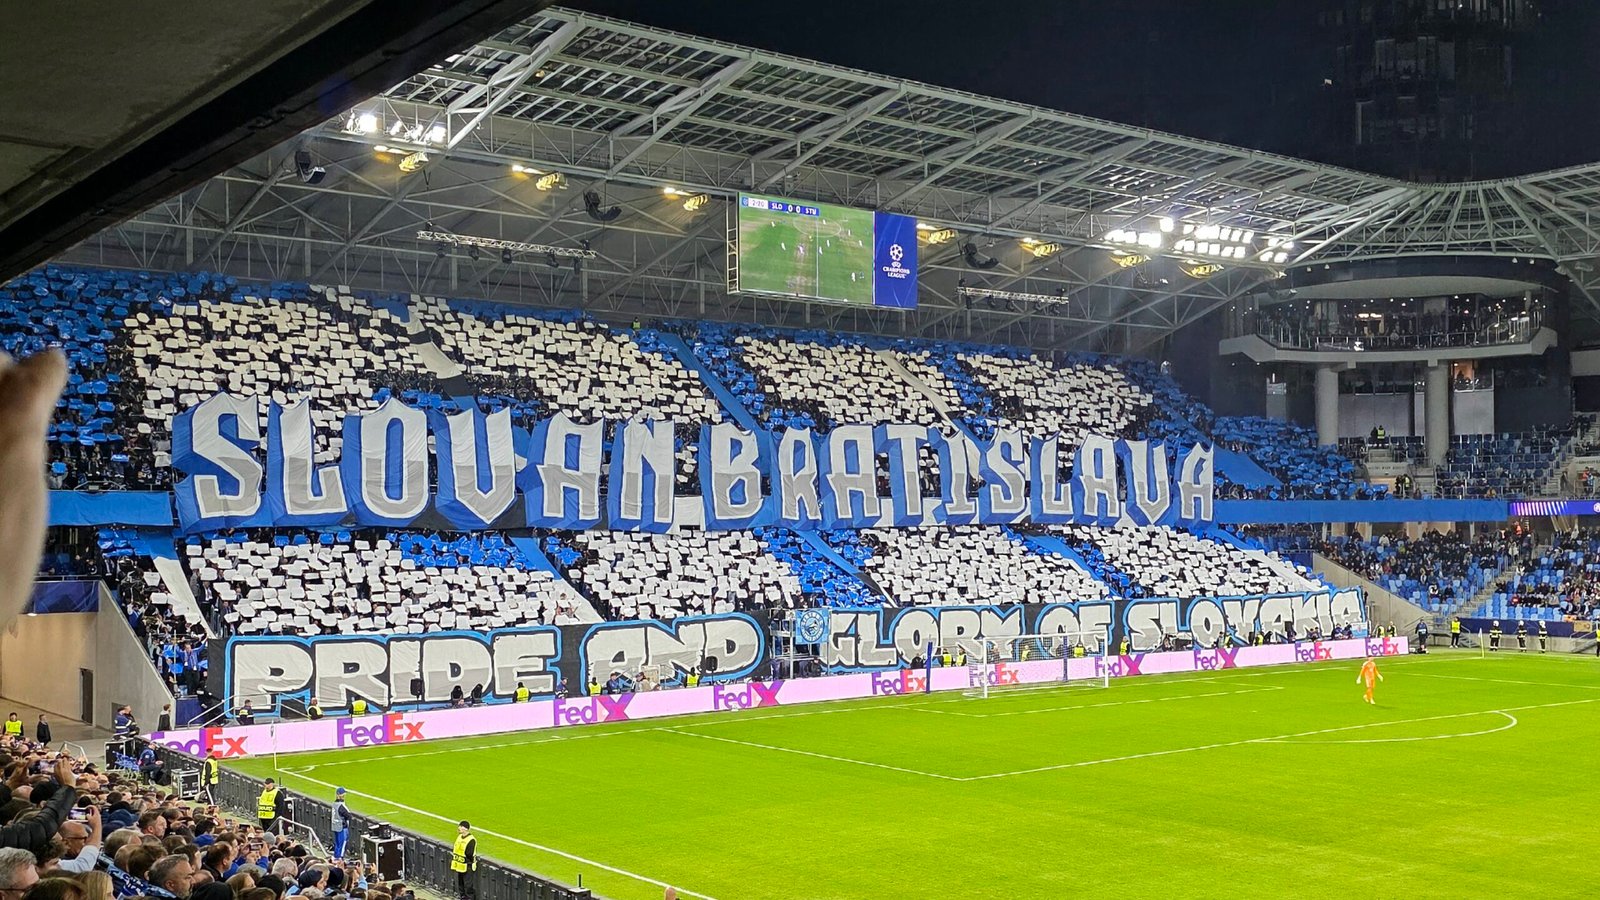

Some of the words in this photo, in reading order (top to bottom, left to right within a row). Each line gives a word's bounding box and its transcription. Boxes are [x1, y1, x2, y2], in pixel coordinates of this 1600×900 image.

[787, 204, 793, 212] 0
[795, 206, 801, 214] 0
[190, 393, 676, 526] SLOVAN
[710, 422, 1215, 526] BRATISLAVA
[233, 633, 556, 711] PRIDE
[585, 618, 760, 690] AND
[820, 607, 1023, 667] GLORY
[1040, 605, 1112, 657] OF
[1127, 590, 1363, 652] SLOVAKIA
[1295, 640, 1332, 662] FedEx
[1365, 636, 1399, 657] FedEx
[871, 669, 927, 696] FedEx
[337, 713, 425, 747] FedEx
